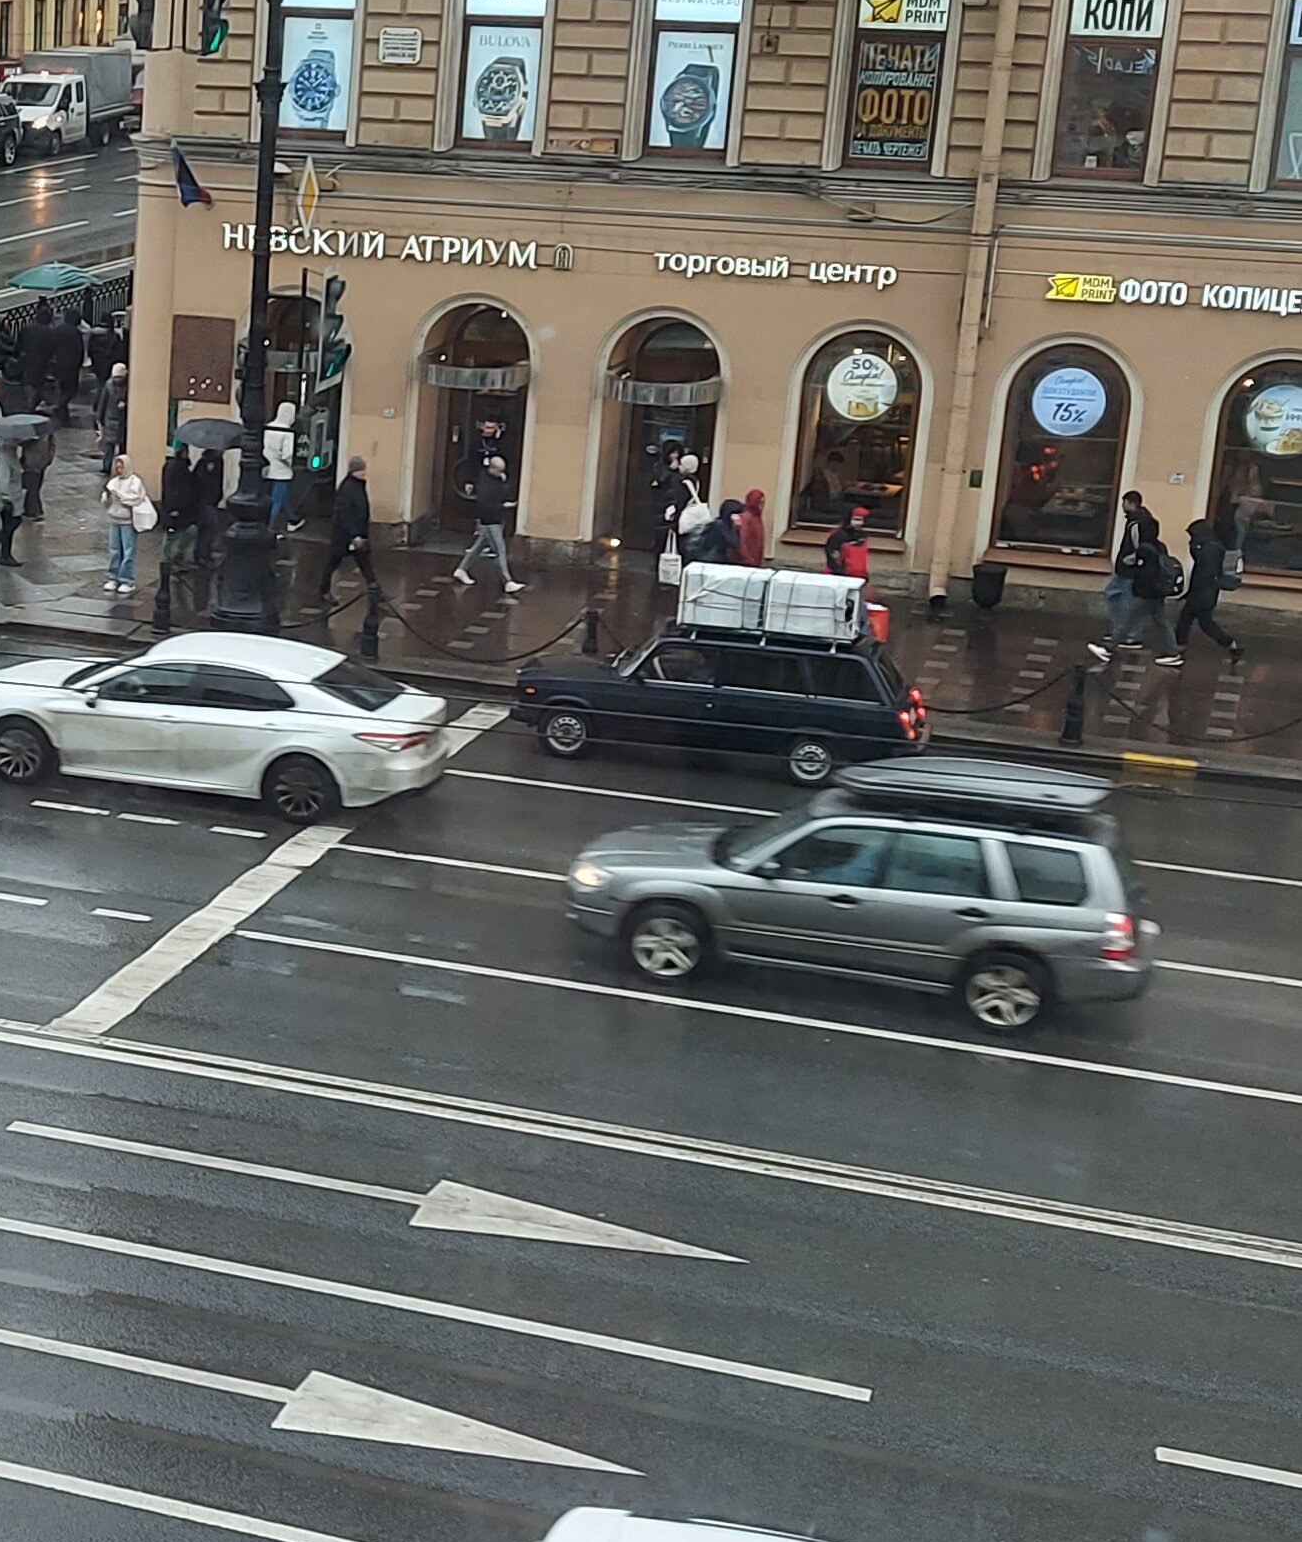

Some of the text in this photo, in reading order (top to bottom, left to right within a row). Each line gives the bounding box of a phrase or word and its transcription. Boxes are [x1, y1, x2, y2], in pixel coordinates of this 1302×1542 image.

[904, 9, 947, 24] PRINT
[479, 34, 531, 48] BULOVA
[862, 42, 936, 73] ПЕЧАТЬ
[859, 70, 935, 88] КОПИРОВАНИЕ
[858, 88, 932, 126] ФОТО
[401, 234, 538, 270] АТРИУМ
[654, 252, 898, 290] торговый центр
[1082, 276, 1111, 289] MDM
[1119, 278, 1188, 306] ФОТО
[1081, 288, 1115, 301] PRINT
[1052, 402, 1088, 423] 15%
